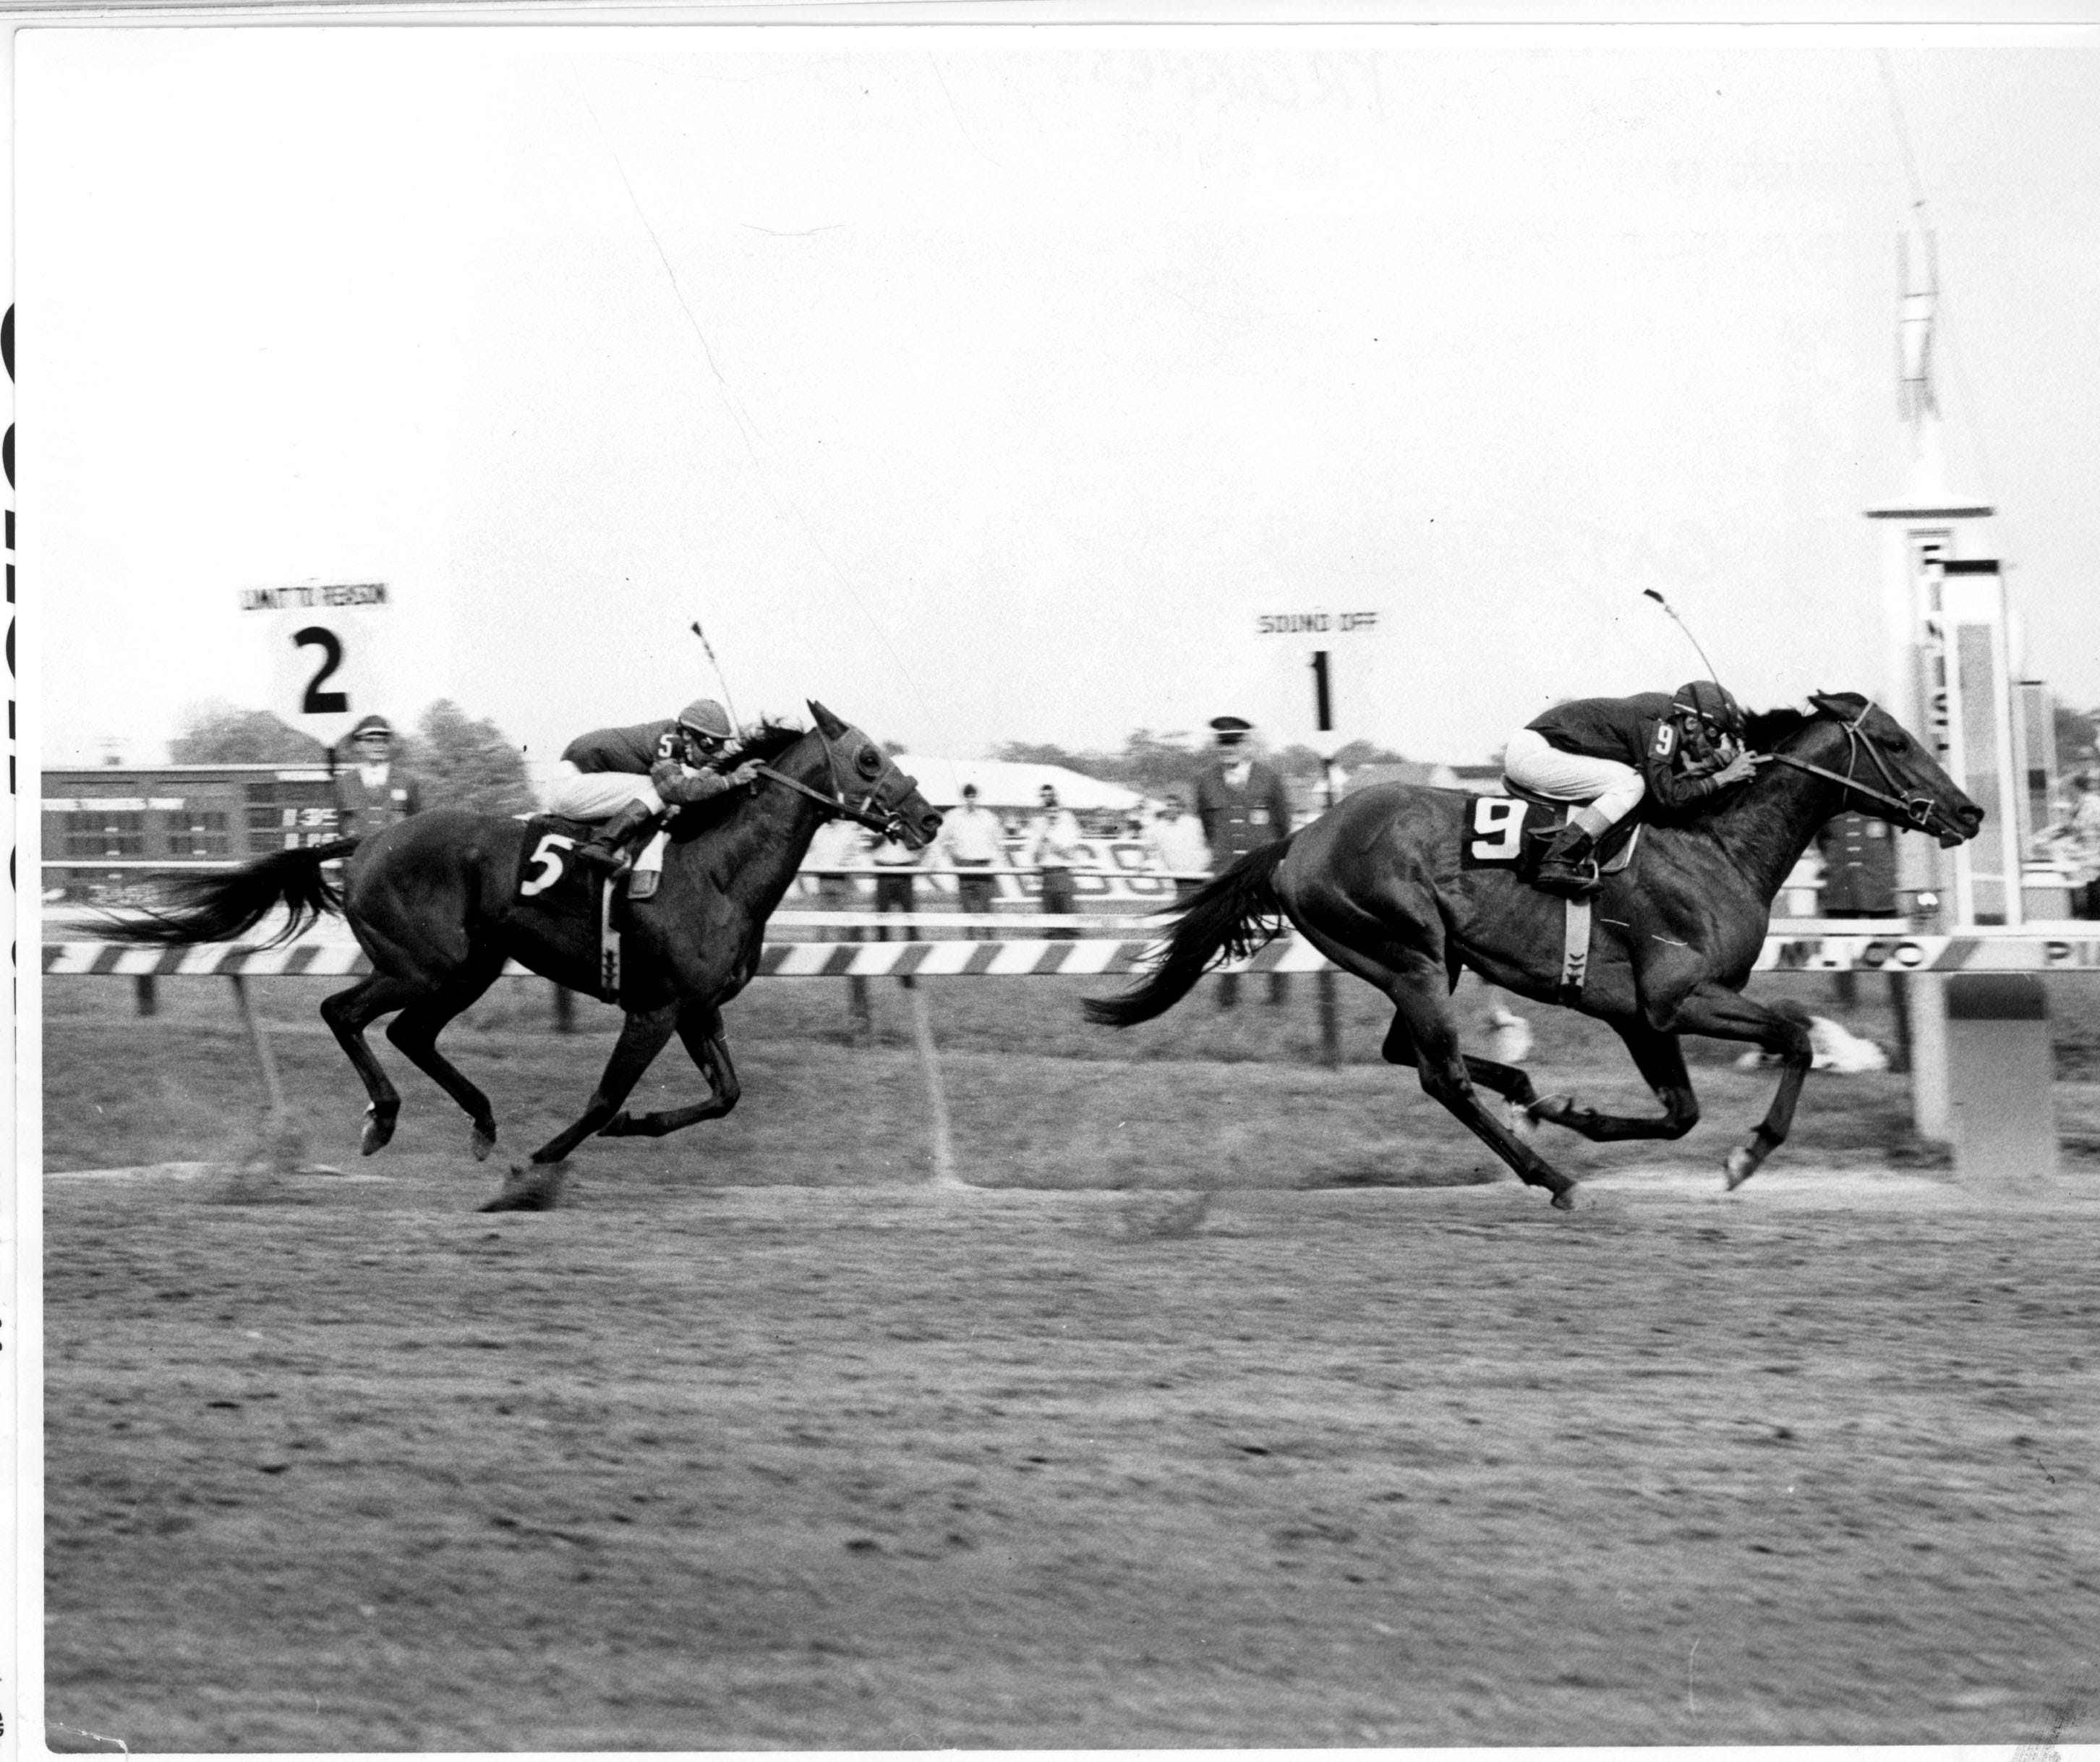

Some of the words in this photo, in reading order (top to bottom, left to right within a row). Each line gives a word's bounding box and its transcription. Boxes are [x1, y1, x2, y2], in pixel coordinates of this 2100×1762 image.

[1259, 613, 1329, 634] SOUND
[1339, 612, 1378, 631] OFF
[293, 626, 349, 714] 2
[1310, 650, 1332, 731] 1
[658, 734, 677, 758] 5
[1655, 725, 1674, 756] 9
[1472, 797, 1529, 860] 9
[520, 833, 576, 896] 5
